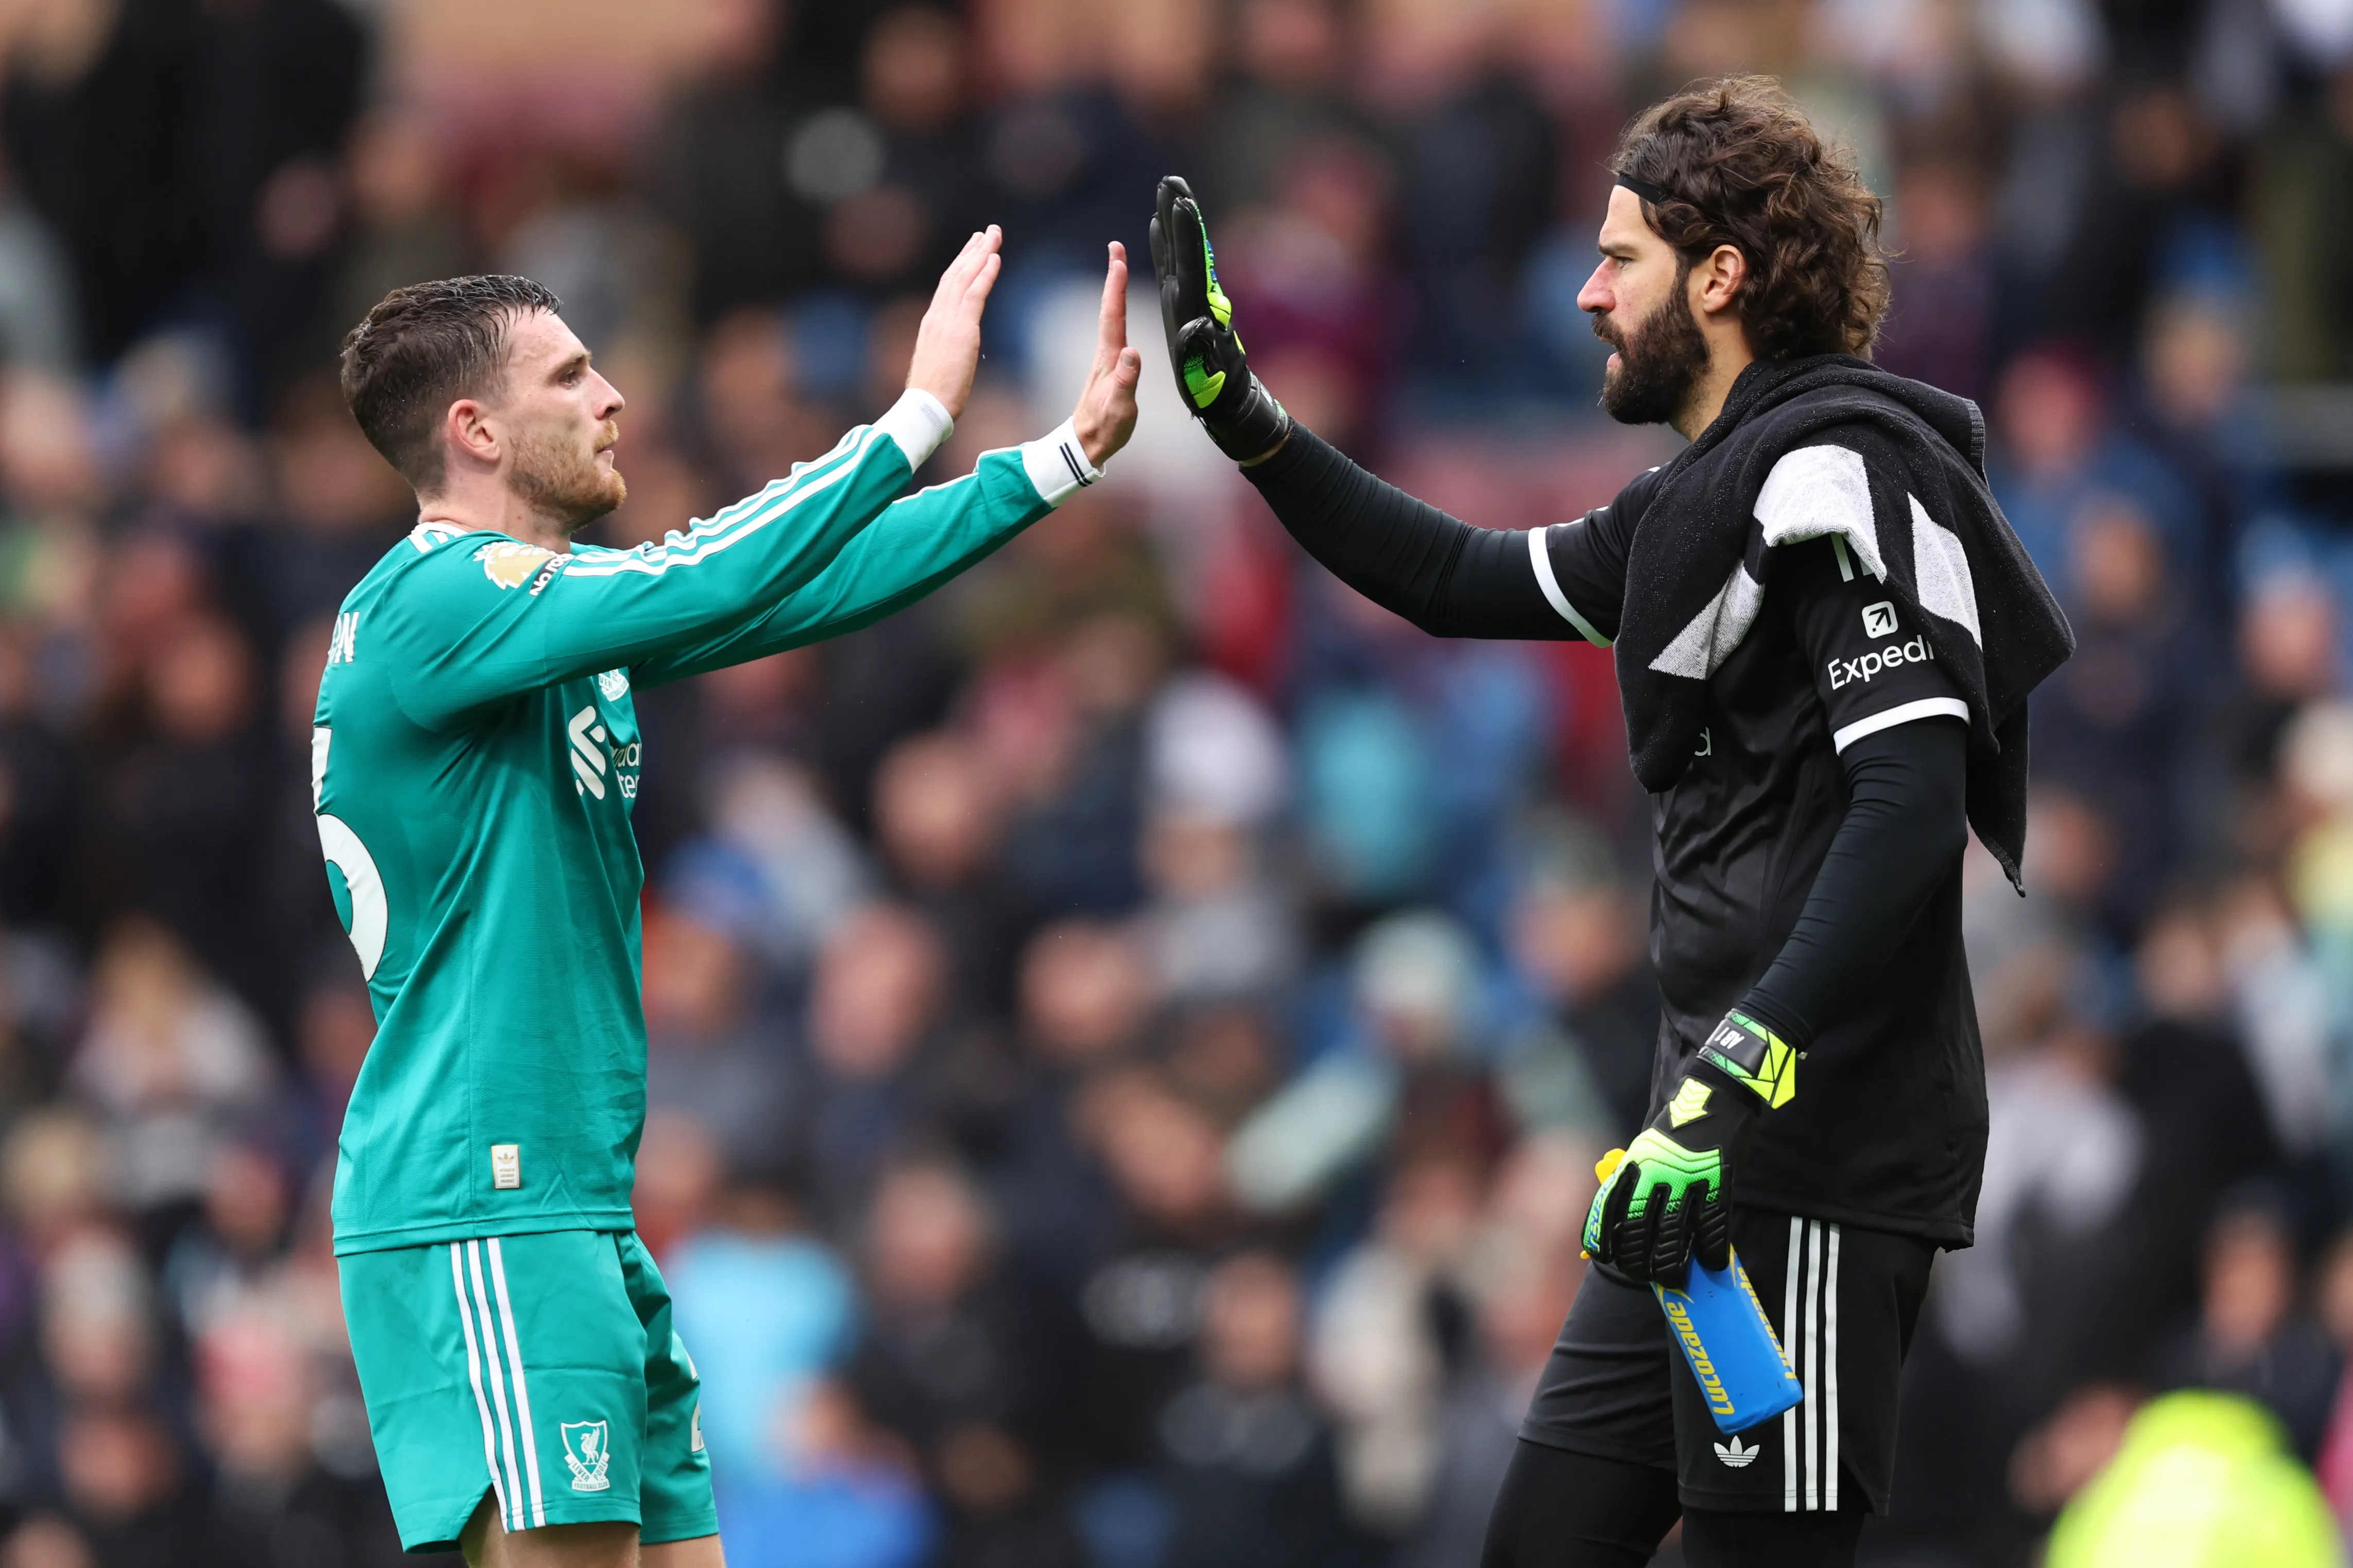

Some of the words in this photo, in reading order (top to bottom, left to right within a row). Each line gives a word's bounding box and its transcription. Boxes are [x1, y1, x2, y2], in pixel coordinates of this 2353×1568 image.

[529, 572, 552, 596] No
[1666, 1301, 1735, 1415] Lucozade
[572, 1462, 590, 1483] LIVER
[593, 1461, 607, 1481] POOL
